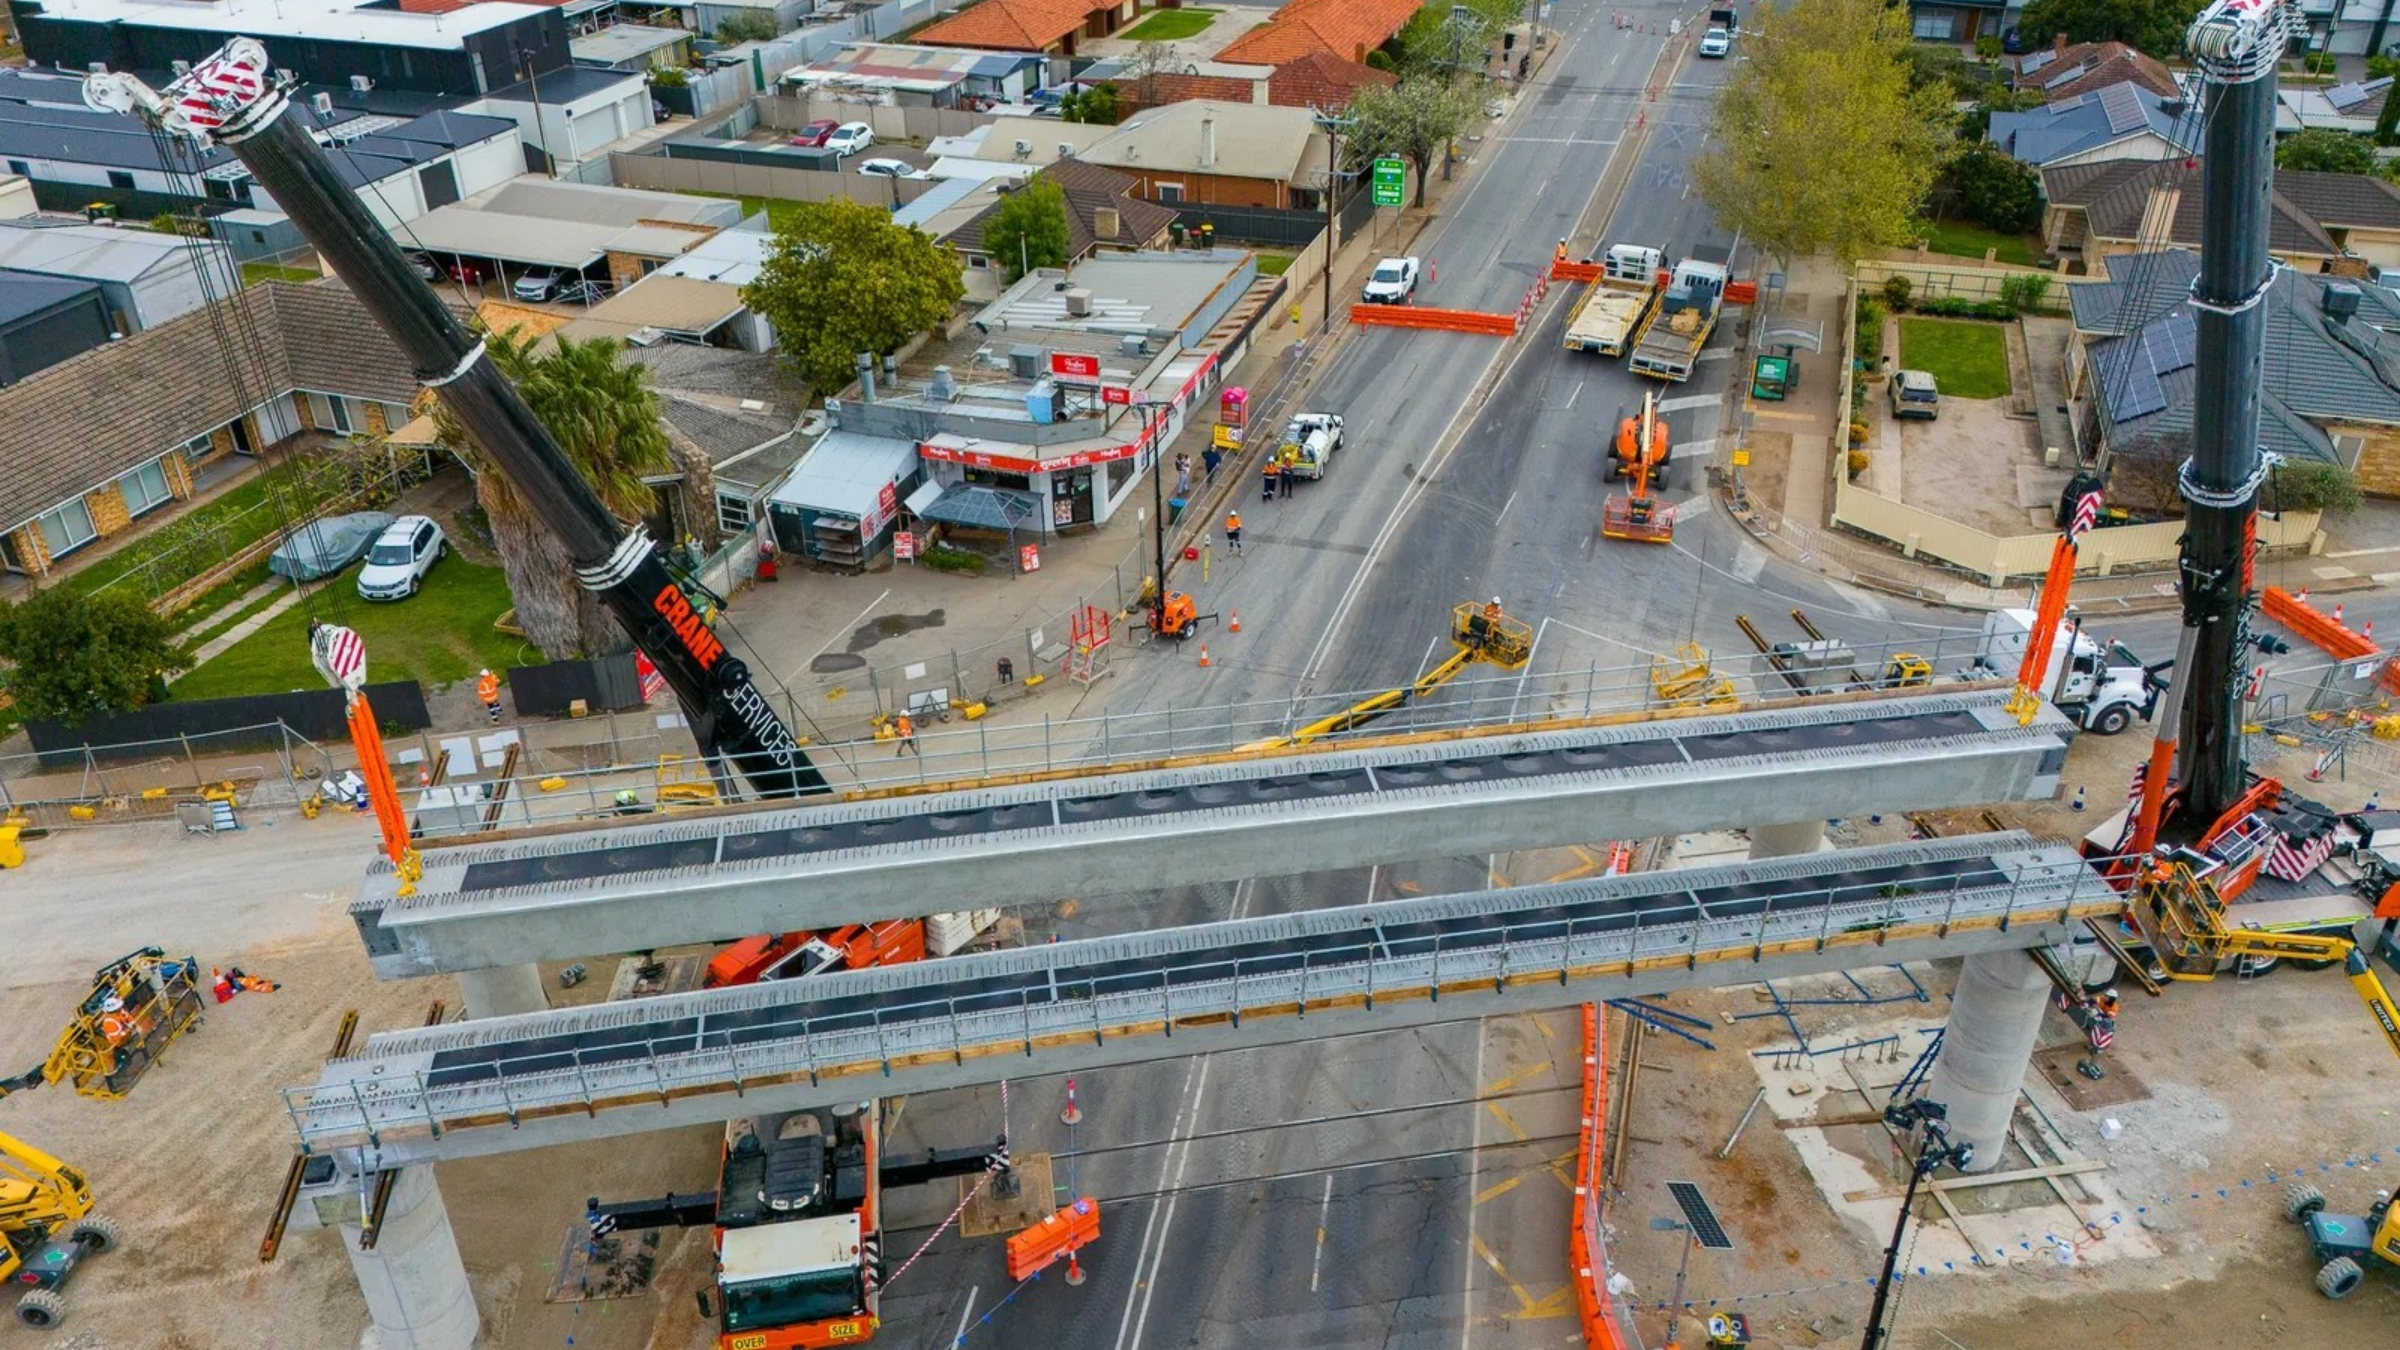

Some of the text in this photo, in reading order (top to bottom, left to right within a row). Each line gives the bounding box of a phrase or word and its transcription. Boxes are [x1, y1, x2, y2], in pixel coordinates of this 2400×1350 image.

[653, 583, 724, 671] CRANE
[734, 1324, 856, 1350] OVER SIZE
